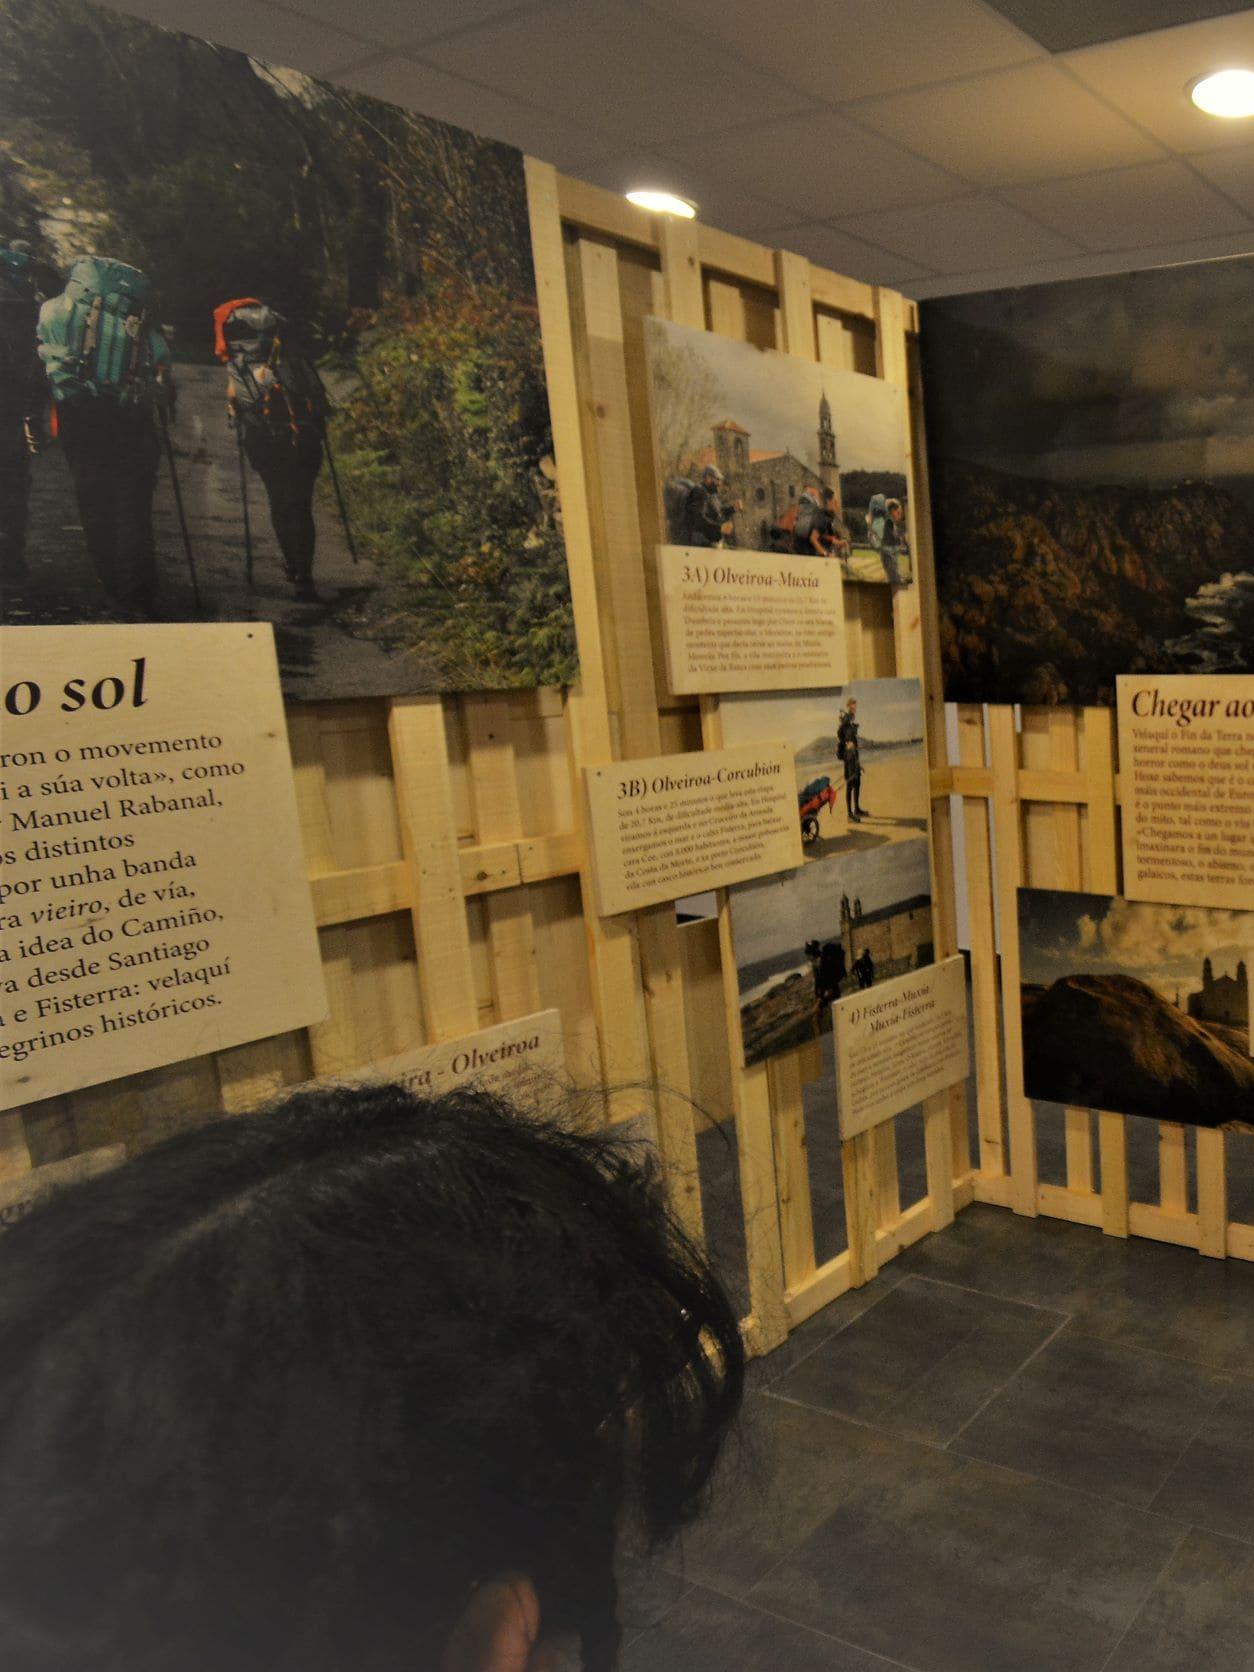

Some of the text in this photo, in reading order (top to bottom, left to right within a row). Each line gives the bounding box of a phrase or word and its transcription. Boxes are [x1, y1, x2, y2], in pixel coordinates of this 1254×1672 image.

[61, 657, 148, 712] sol
[1131, 689, 1220, 727] Chegar
[55, 749, 71, 762] o
[79, 733, 223, 760] movemento
[1181, 725, 1196, 738] Fin
[1217, 726, 1242, 739] Terra
[1212, 746, 1231, 758] que
[18, 783, 32, 798] a
[41, 773, 84, 796] súa
[90, 768, 175, 790] volta»,
[181, 759, 246, 782] como
[617, 761, 783, 801] 3B) Olveiroa-Corcubión
[1168, 759, 1195, 768] como
[1208, 775, 1225, 787] que
[10, 788, 223, 832] Manuel Rabanal,
[25, 831, 135, 862] distintos
[0, 851, 197, 905] por unha banda
[31, 899, 110, 924] vieiro,
[118, 887, 147, 909] de
[155, 880, 196, 904] vía,
[19, 935, 74, 958] idea
[82, 926, 113, 945] do
[121, 907, 224, 939] Camiño,
[28, 958, 100, 988] desde
[108, 938, 210, 972] Santiago
[14, 956, 231, 1023] e Fisterra: velaquí
[0, 993, 223, 1061] egrinos históricos.
[450, 1034, 540, 1075] Olveiroa
